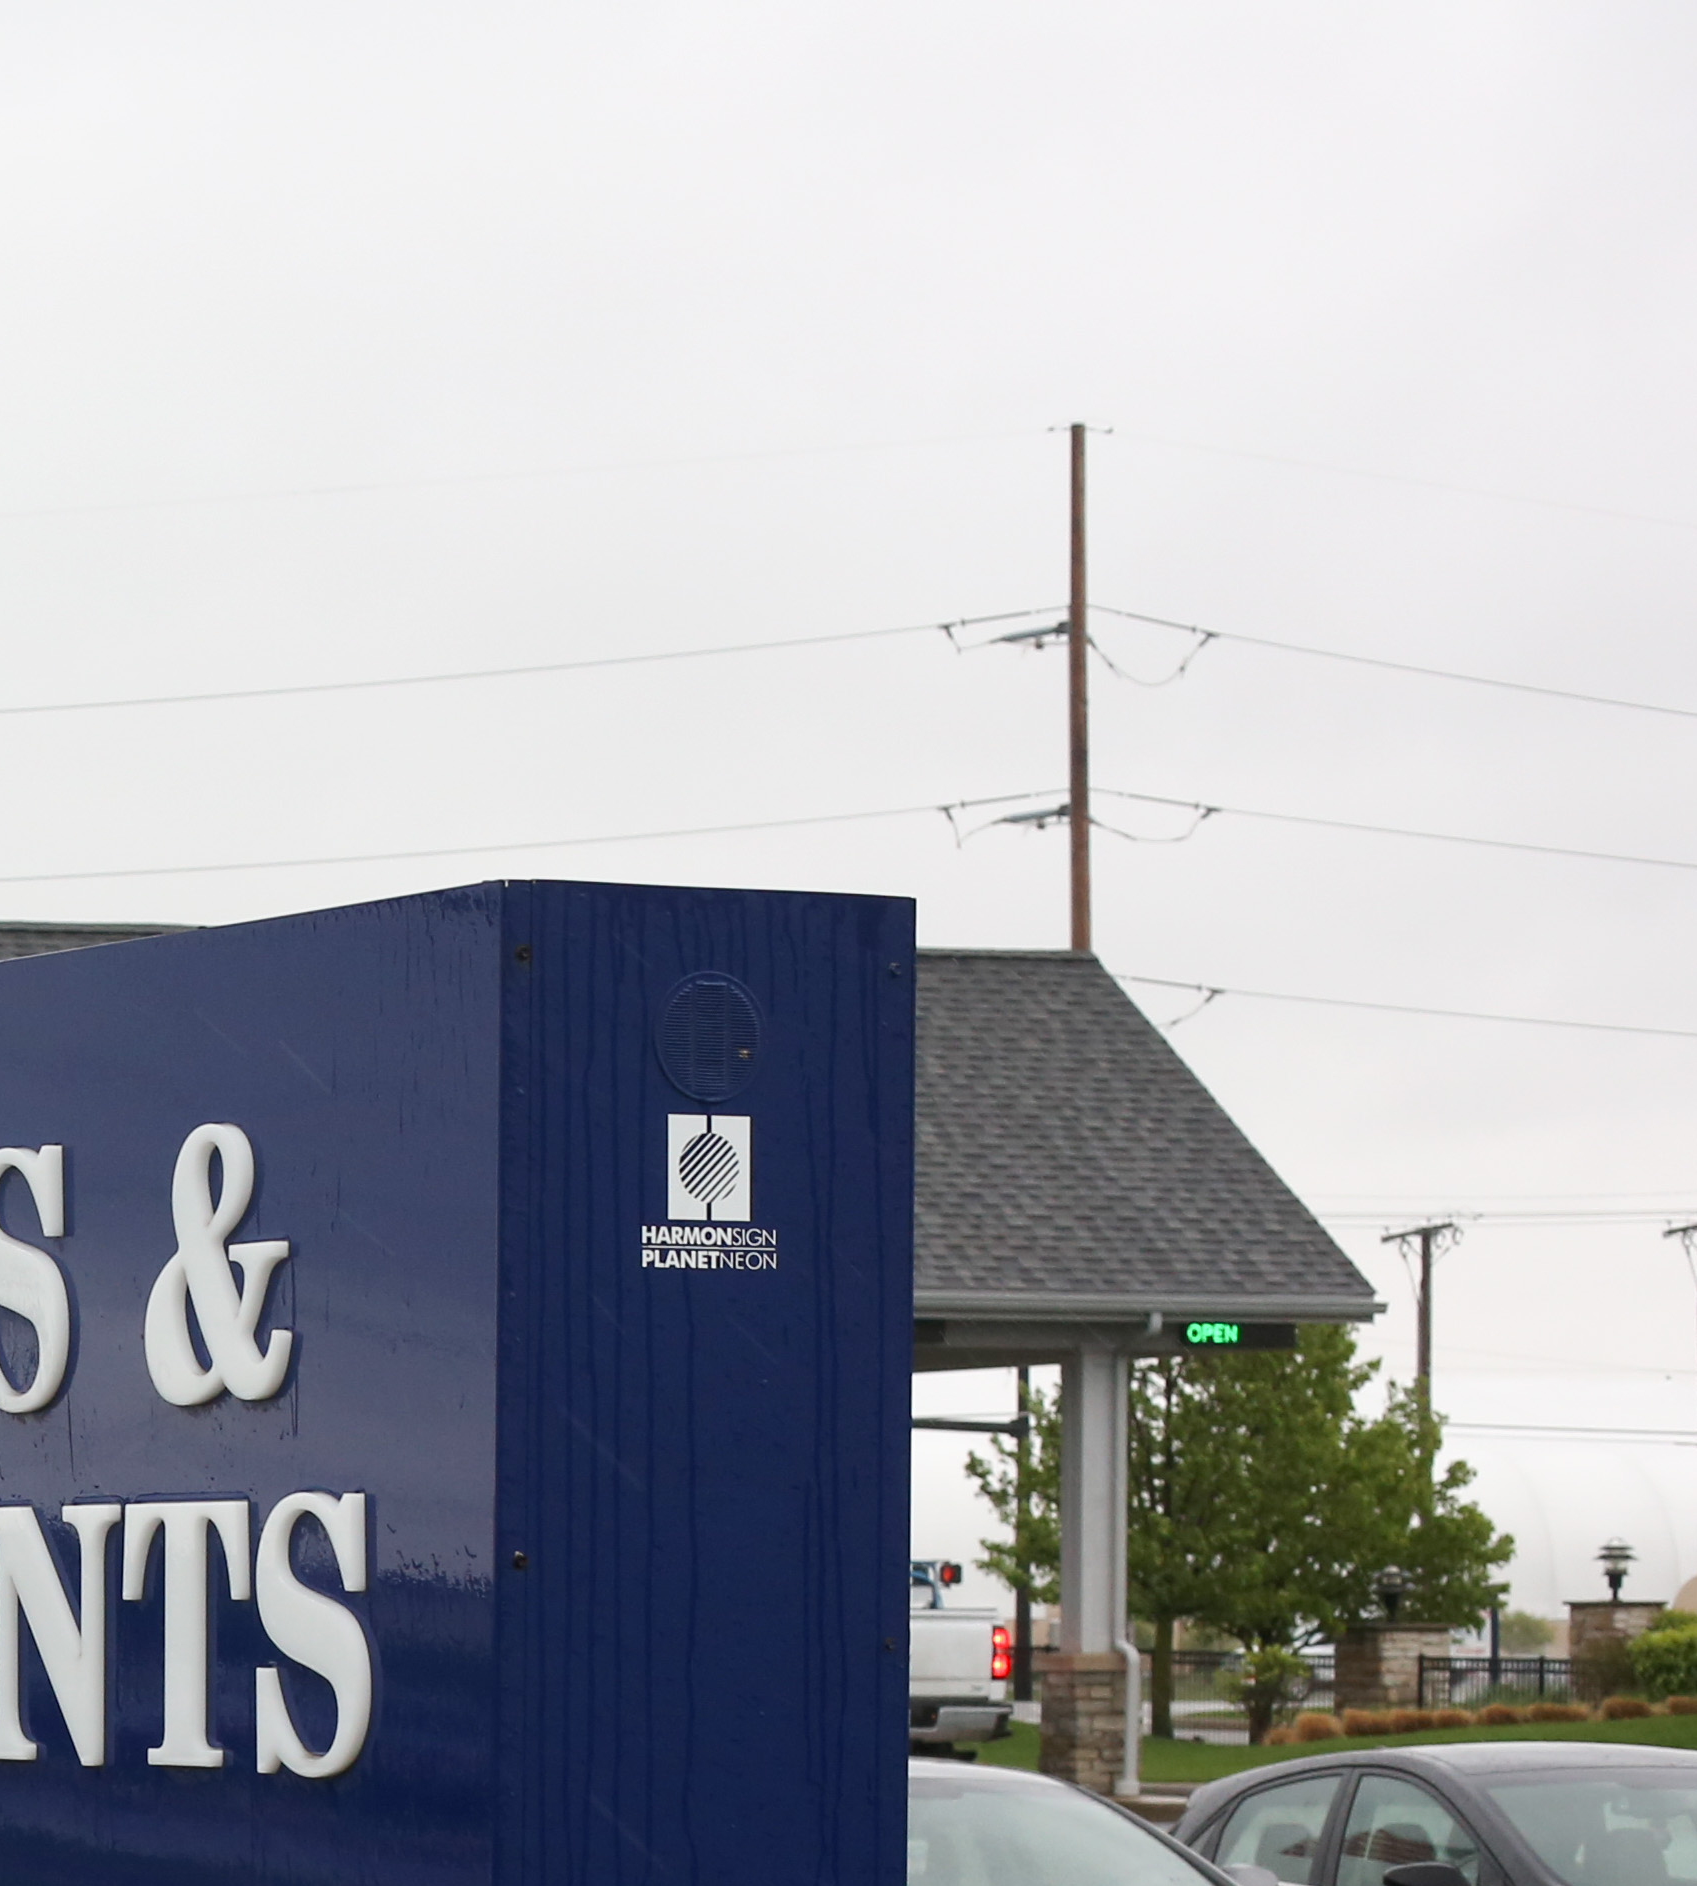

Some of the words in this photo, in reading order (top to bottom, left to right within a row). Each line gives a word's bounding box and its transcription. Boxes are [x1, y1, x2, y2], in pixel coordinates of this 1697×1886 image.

[641, 1225, 777, 1247] HARMONSIGN
[144, 1123, 292, 1406] &
[641, 1249, 777, 1270] PLANETNEON
[1186, 1322, 1239, 1344] OPEN
